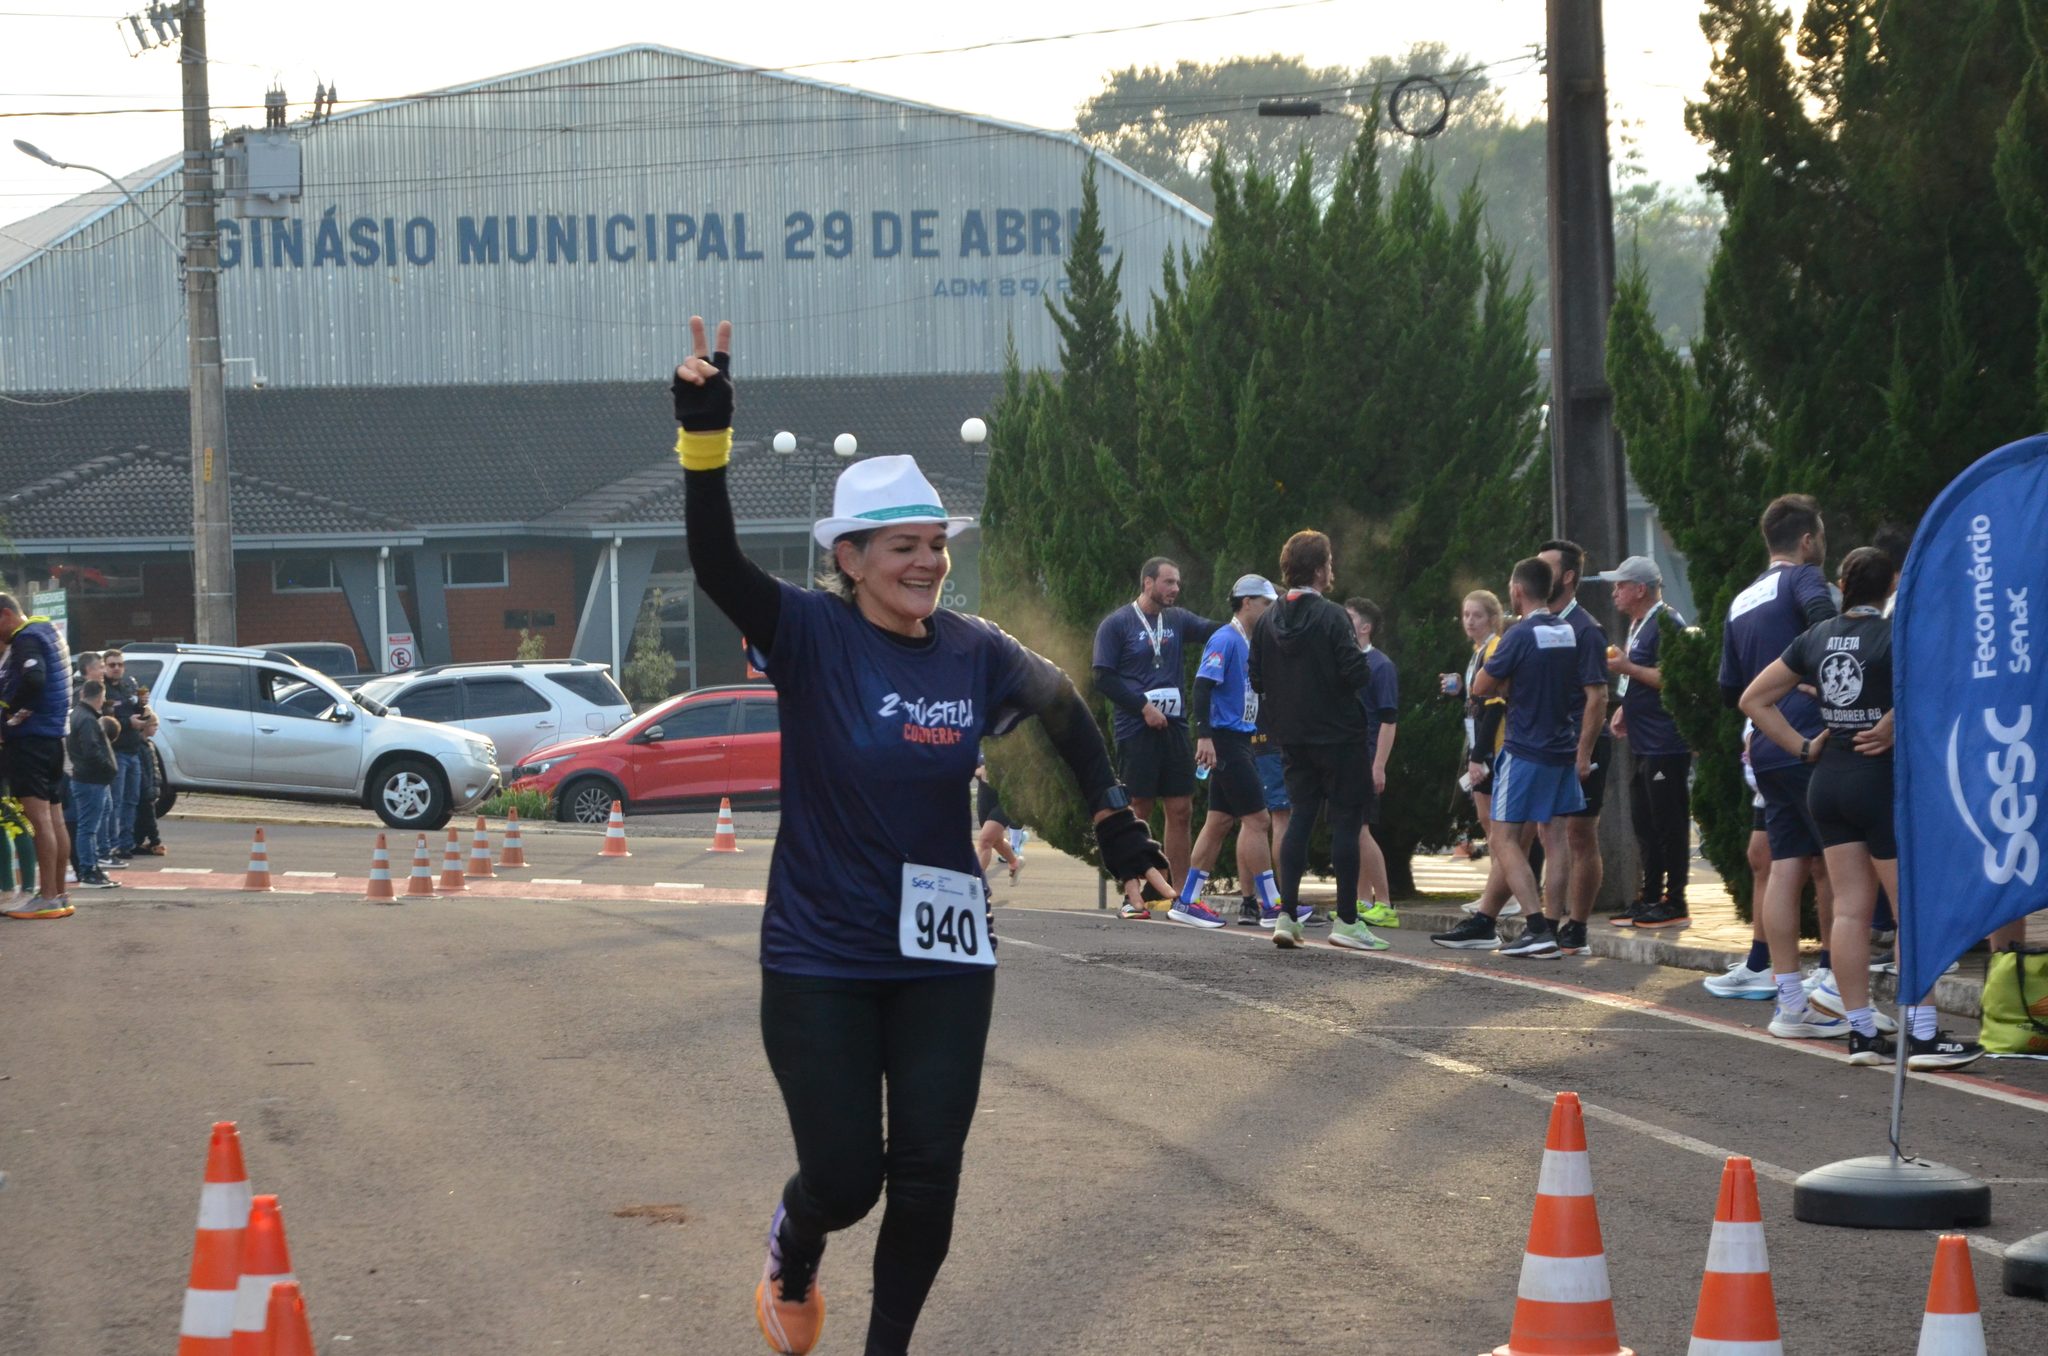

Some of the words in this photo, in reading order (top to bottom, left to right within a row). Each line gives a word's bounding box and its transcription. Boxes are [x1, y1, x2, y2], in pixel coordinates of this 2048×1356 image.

[217, 205, 437, 268] GINÁSIO
[457, 212, 764, 265] MUNICIPAL
[784, 210, 854, 260] 29
[872, 209, 941, 258] DE
[1966, 514, 1997, 679] Fecomércio
[1826, 636, 1860, 651] ATLETA
[1833, 709, 1866, 722] CORRER
[1868, 707, 1882, 720] RB
[916, 901, 977, 956] 940
[1937, 1043, 1964, 1052] FILA
